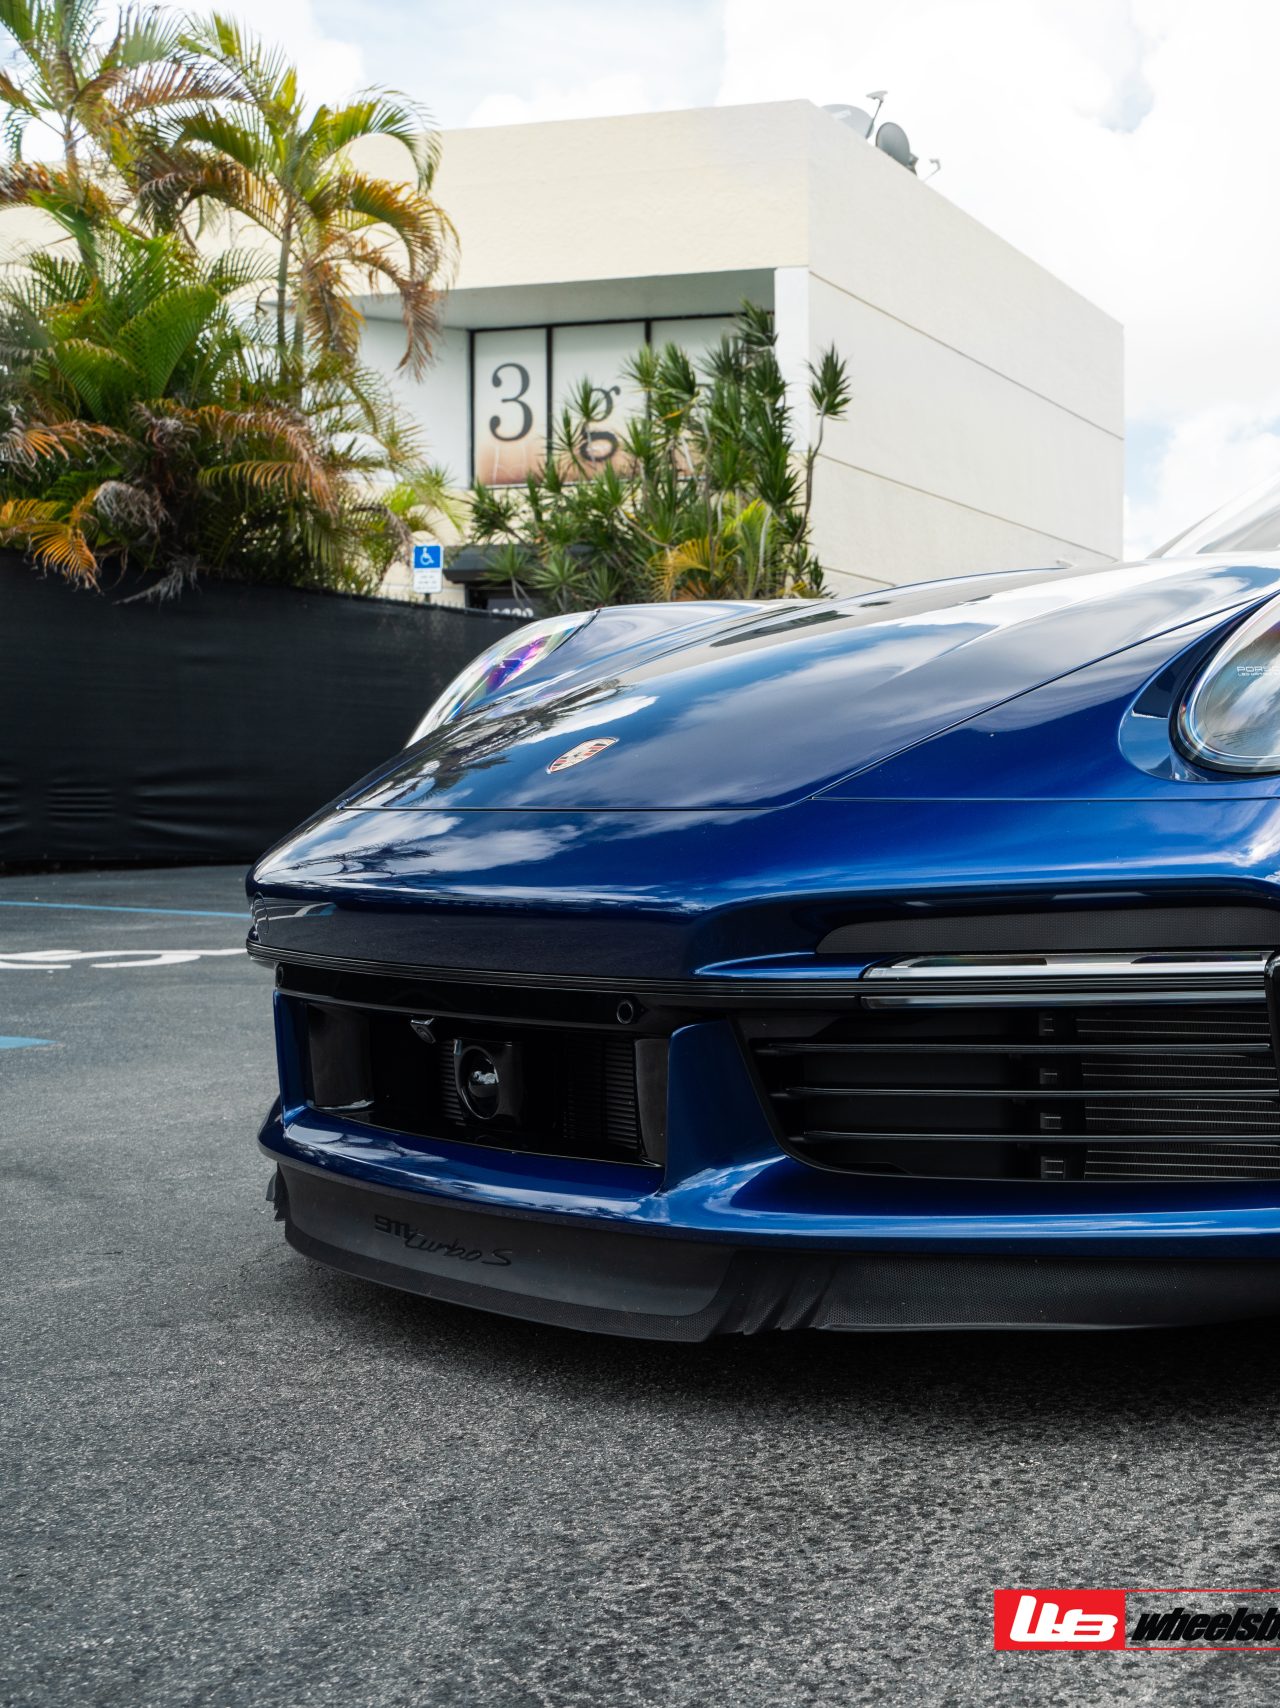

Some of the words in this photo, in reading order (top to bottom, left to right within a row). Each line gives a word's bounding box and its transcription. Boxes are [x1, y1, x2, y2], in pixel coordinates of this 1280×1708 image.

[375, 1214, 410, 1238] 911
[405, 1229, 482, 1261] turbo
[481, 1249, 512, 1266] S
